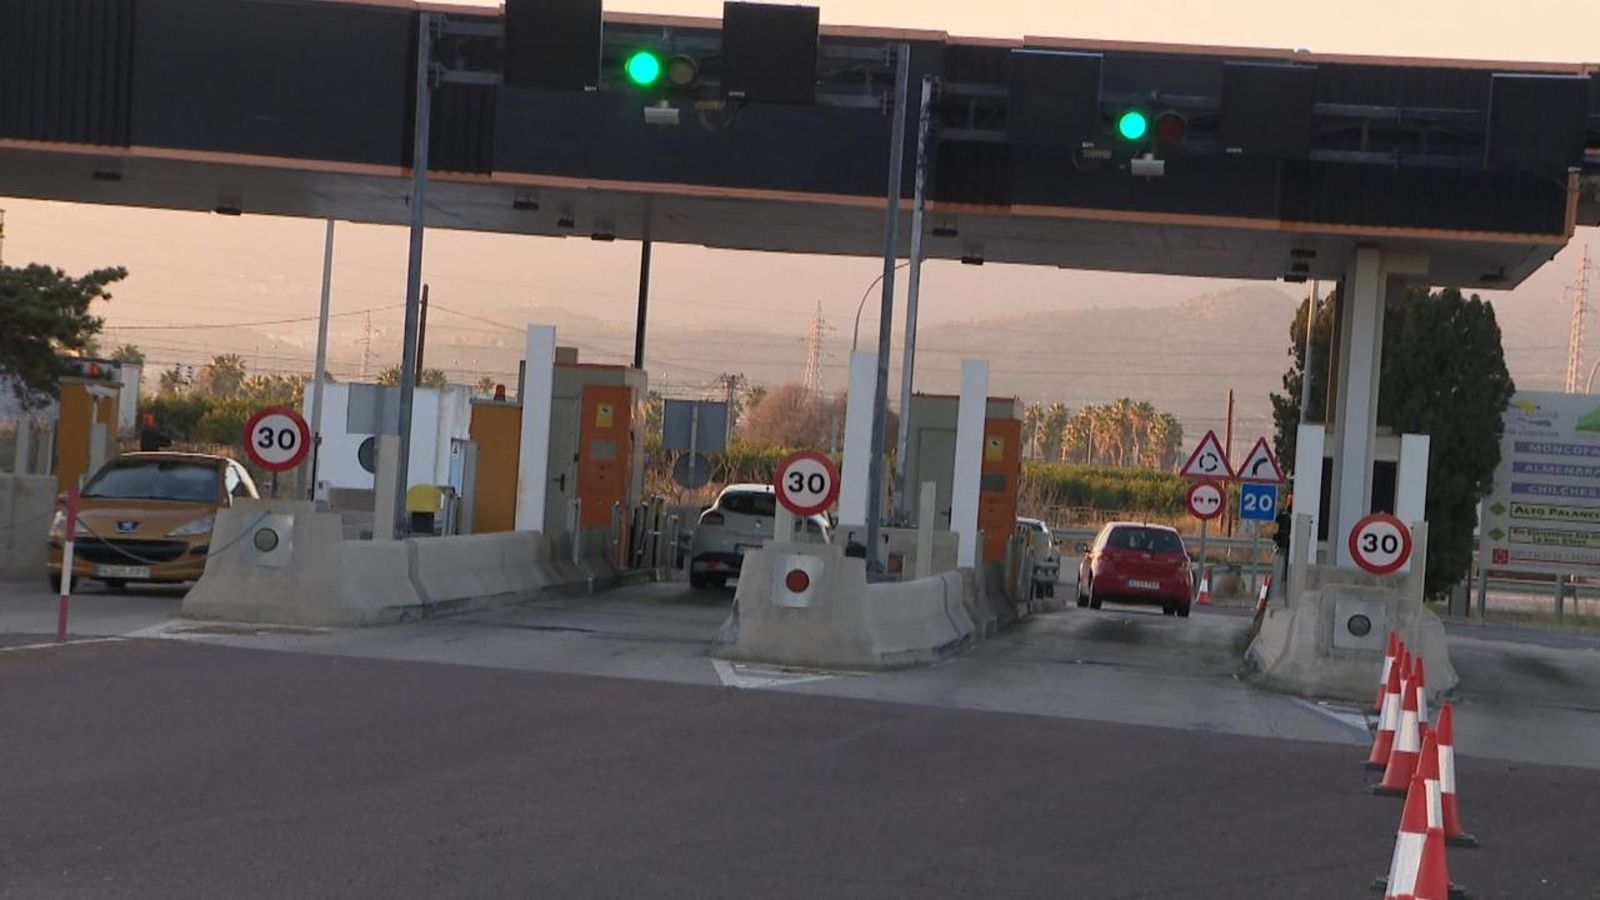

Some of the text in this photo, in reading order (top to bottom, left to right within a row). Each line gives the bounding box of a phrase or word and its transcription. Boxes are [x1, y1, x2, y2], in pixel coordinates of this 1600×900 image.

[258, 426, 296, 450] 30
[788, 471, 825, 494] 30
[1244, 493, 1273, 512] 20
[1363, 533, 1398, 554] 30
